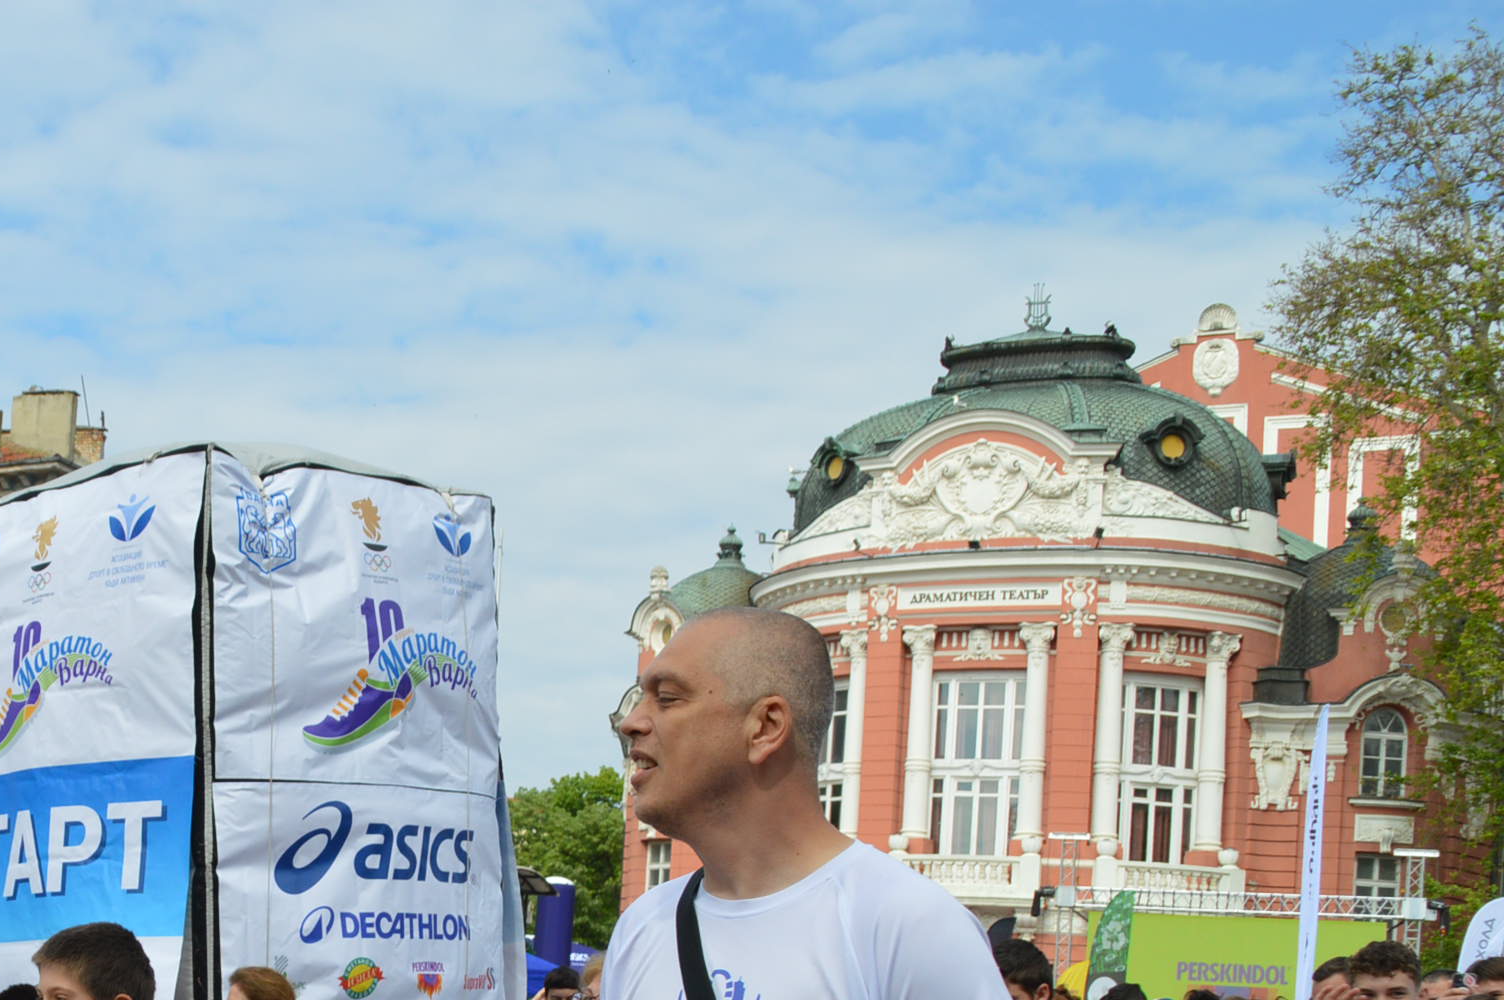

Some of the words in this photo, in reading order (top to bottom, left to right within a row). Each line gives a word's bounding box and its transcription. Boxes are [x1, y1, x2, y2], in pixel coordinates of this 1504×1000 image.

[910, 590, 995, 604] ДРАМАТИЧЕН
[1000, 588, 1049, 601] ТЕАТЪР
[12, 620, 42, 683] 10
[360, 597, 405, 665] 10
[16, 635, 113, 695] Маратон
[55, 656, 113, 687] Варна
[378, 632, 477, 687] Маратон
[424, 654, 478, 700] Варна
[340, 911, 471, 940] DECATHLON
[1176, 961, 1288, 985] PERSKINDOL
